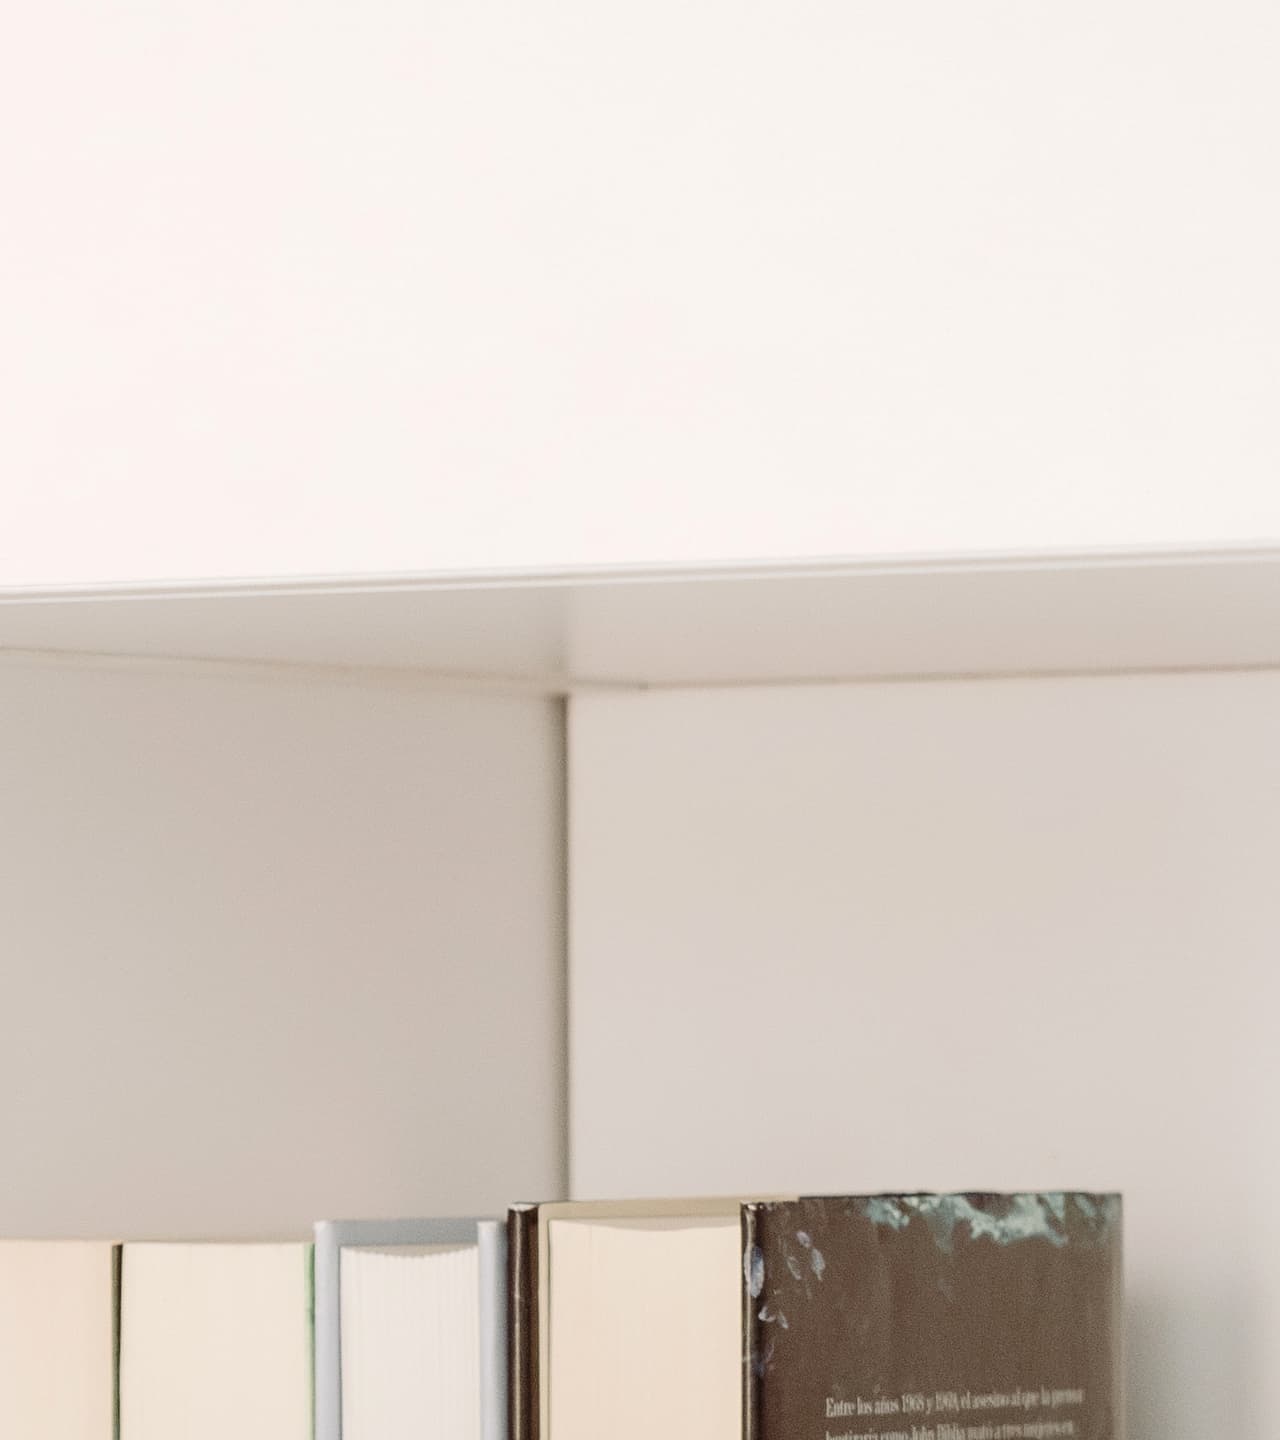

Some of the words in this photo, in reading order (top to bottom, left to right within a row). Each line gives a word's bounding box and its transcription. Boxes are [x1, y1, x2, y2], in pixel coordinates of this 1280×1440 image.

[826, 1398, 856, 1417] Entre
[857, 1397, 872, 1415] los
[874, 1396, 899, 1415] años
[902, 1394, 925, 1412] 1968
[926, 1398, 934, 1414] y
[960, 1390, 970, 1409] el
[1022, 1392, 1040, 1410] que
